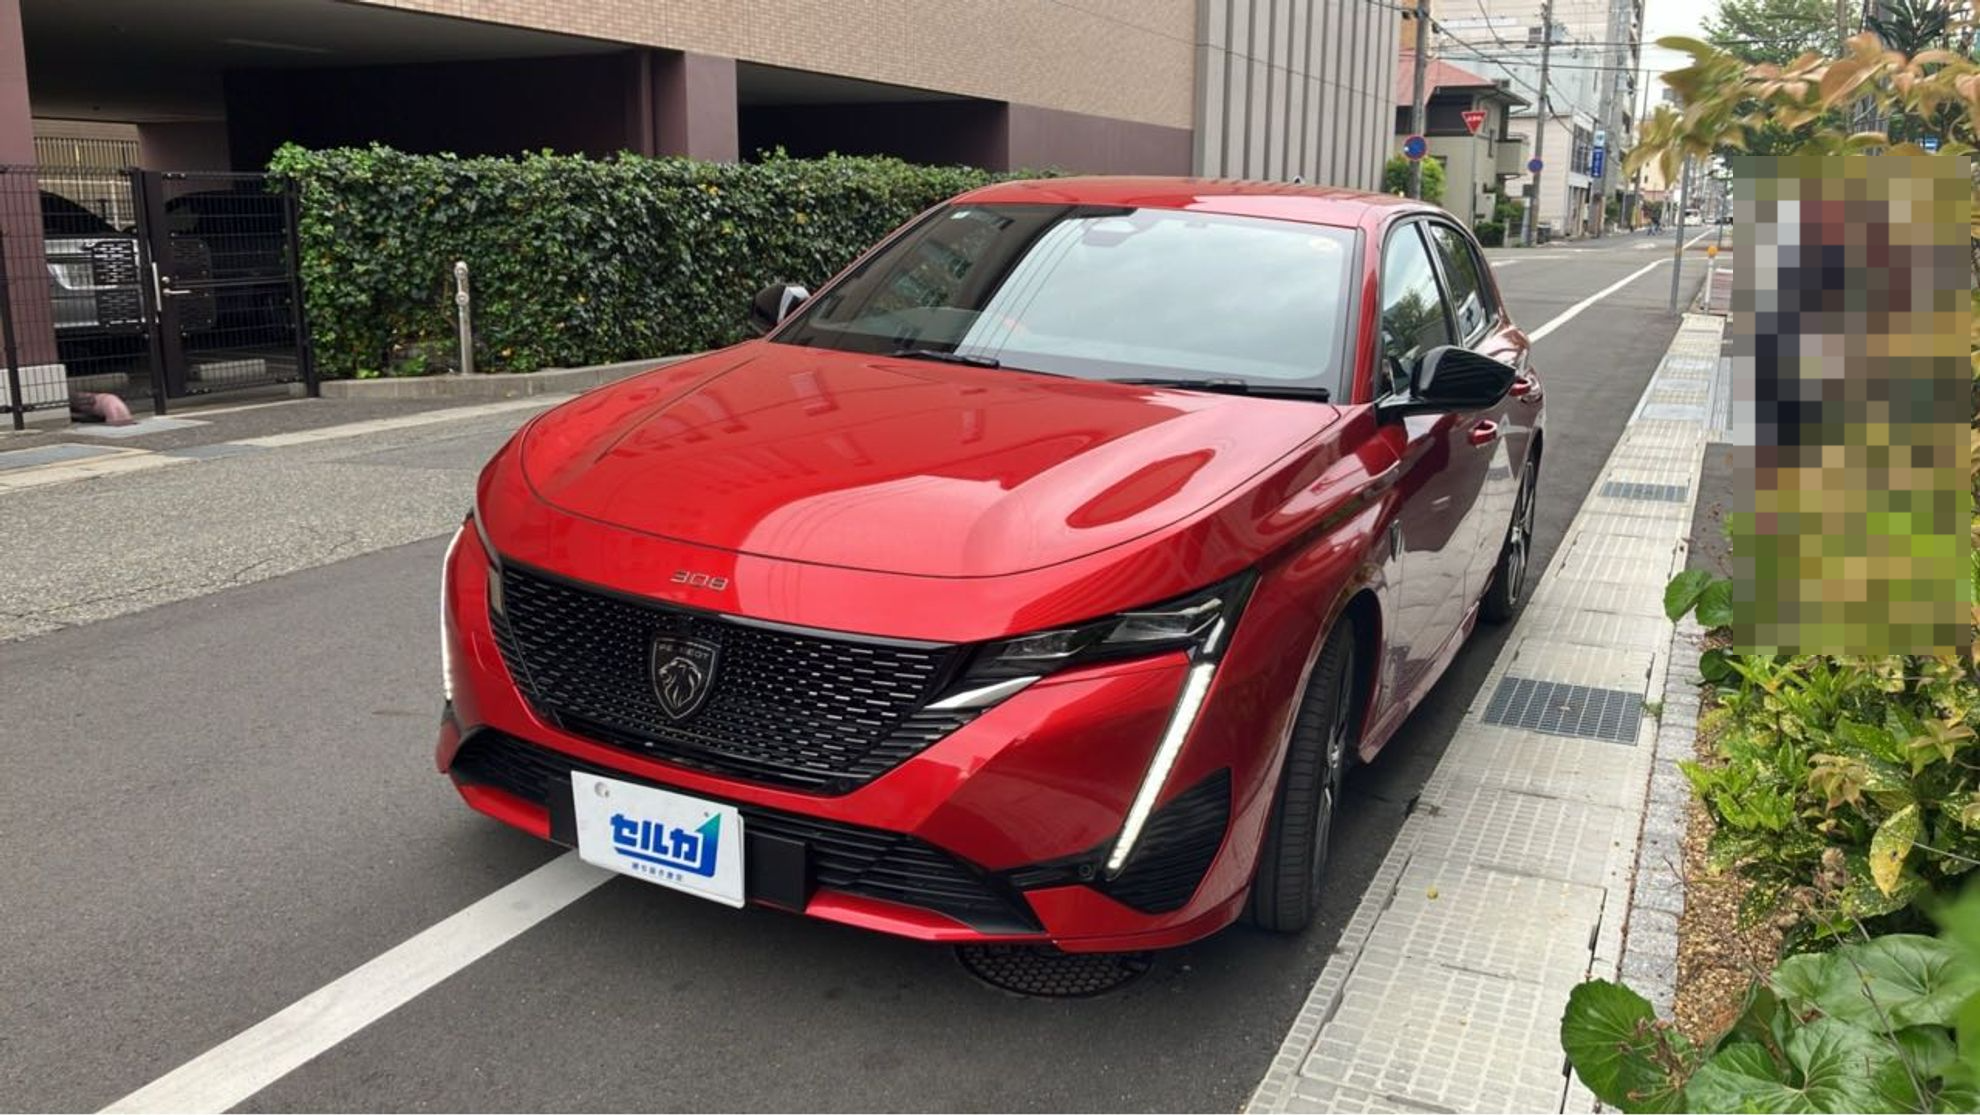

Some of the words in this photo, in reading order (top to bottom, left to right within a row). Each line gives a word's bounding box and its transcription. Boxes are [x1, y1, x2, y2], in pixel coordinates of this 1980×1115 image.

[669, 570, 729, 592] 308
[609, 812, 700, 863] セルカ
